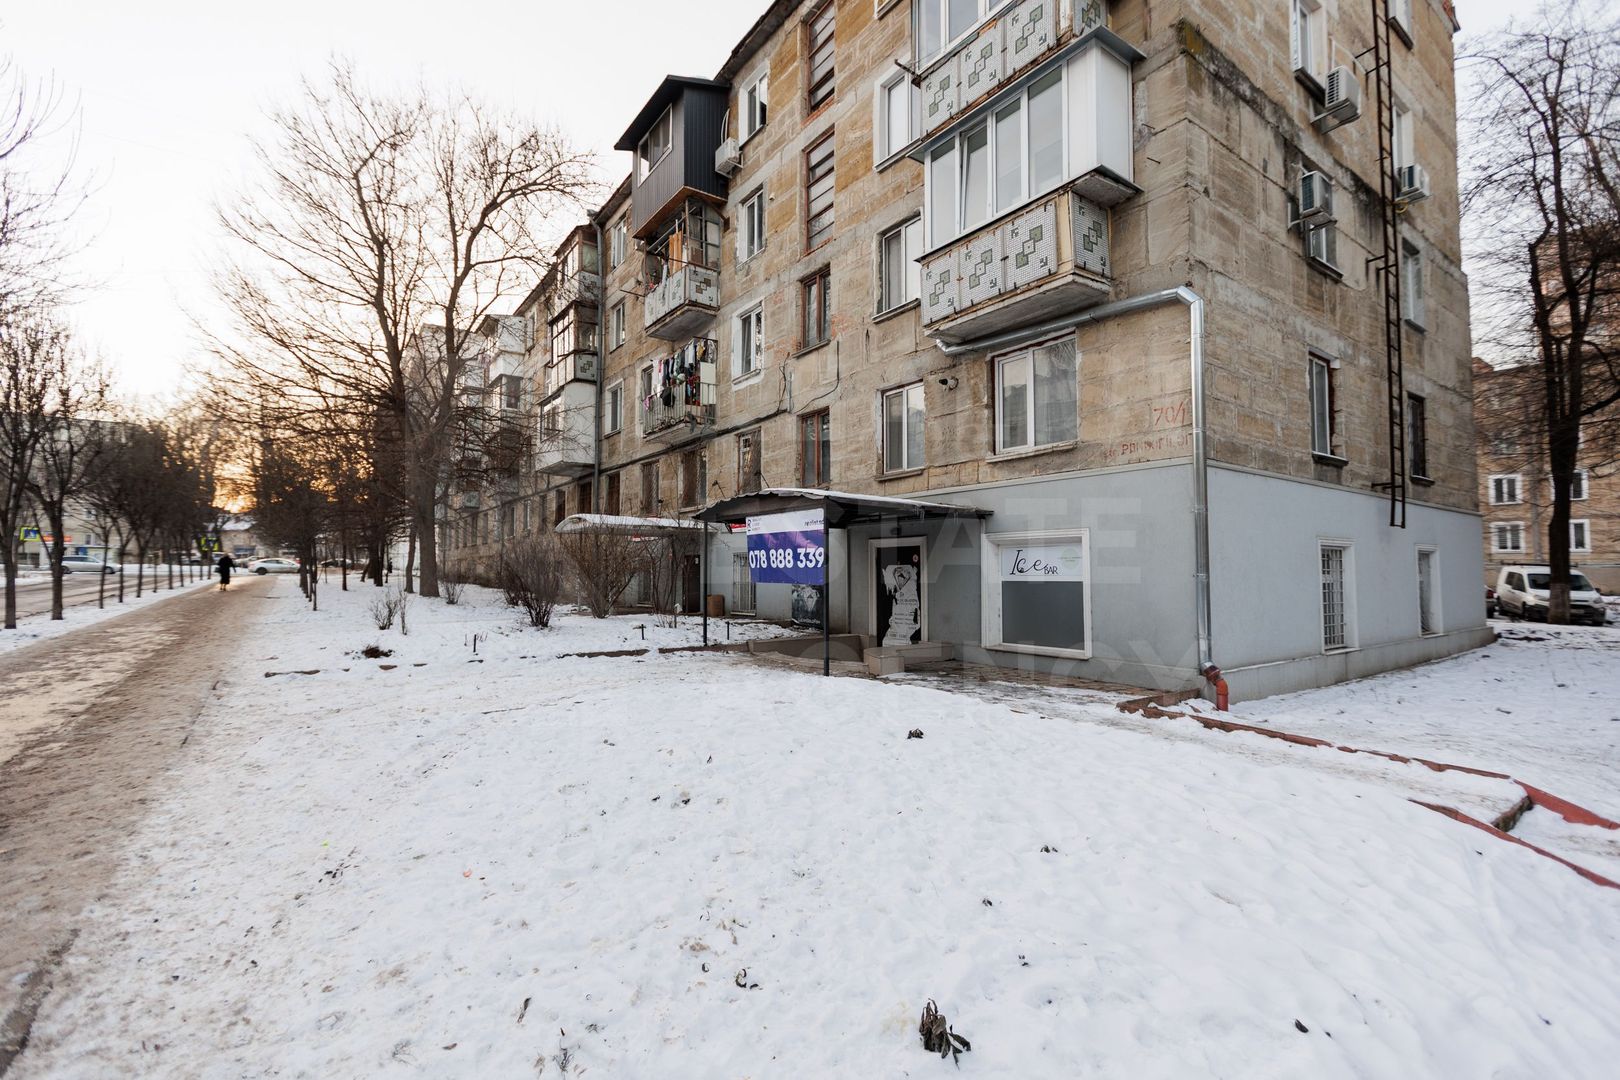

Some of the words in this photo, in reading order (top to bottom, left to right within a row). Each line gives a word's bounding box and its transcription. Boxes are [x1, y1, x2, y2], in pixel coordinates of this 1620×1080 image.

[749, 549, 767, 569] 078
[769, 548, 794, 569] 888
[797, 547, 824, 569] 339
[1009, 549, 1047, 575] Ice
[1044, 565, 1059, 575] BAR
